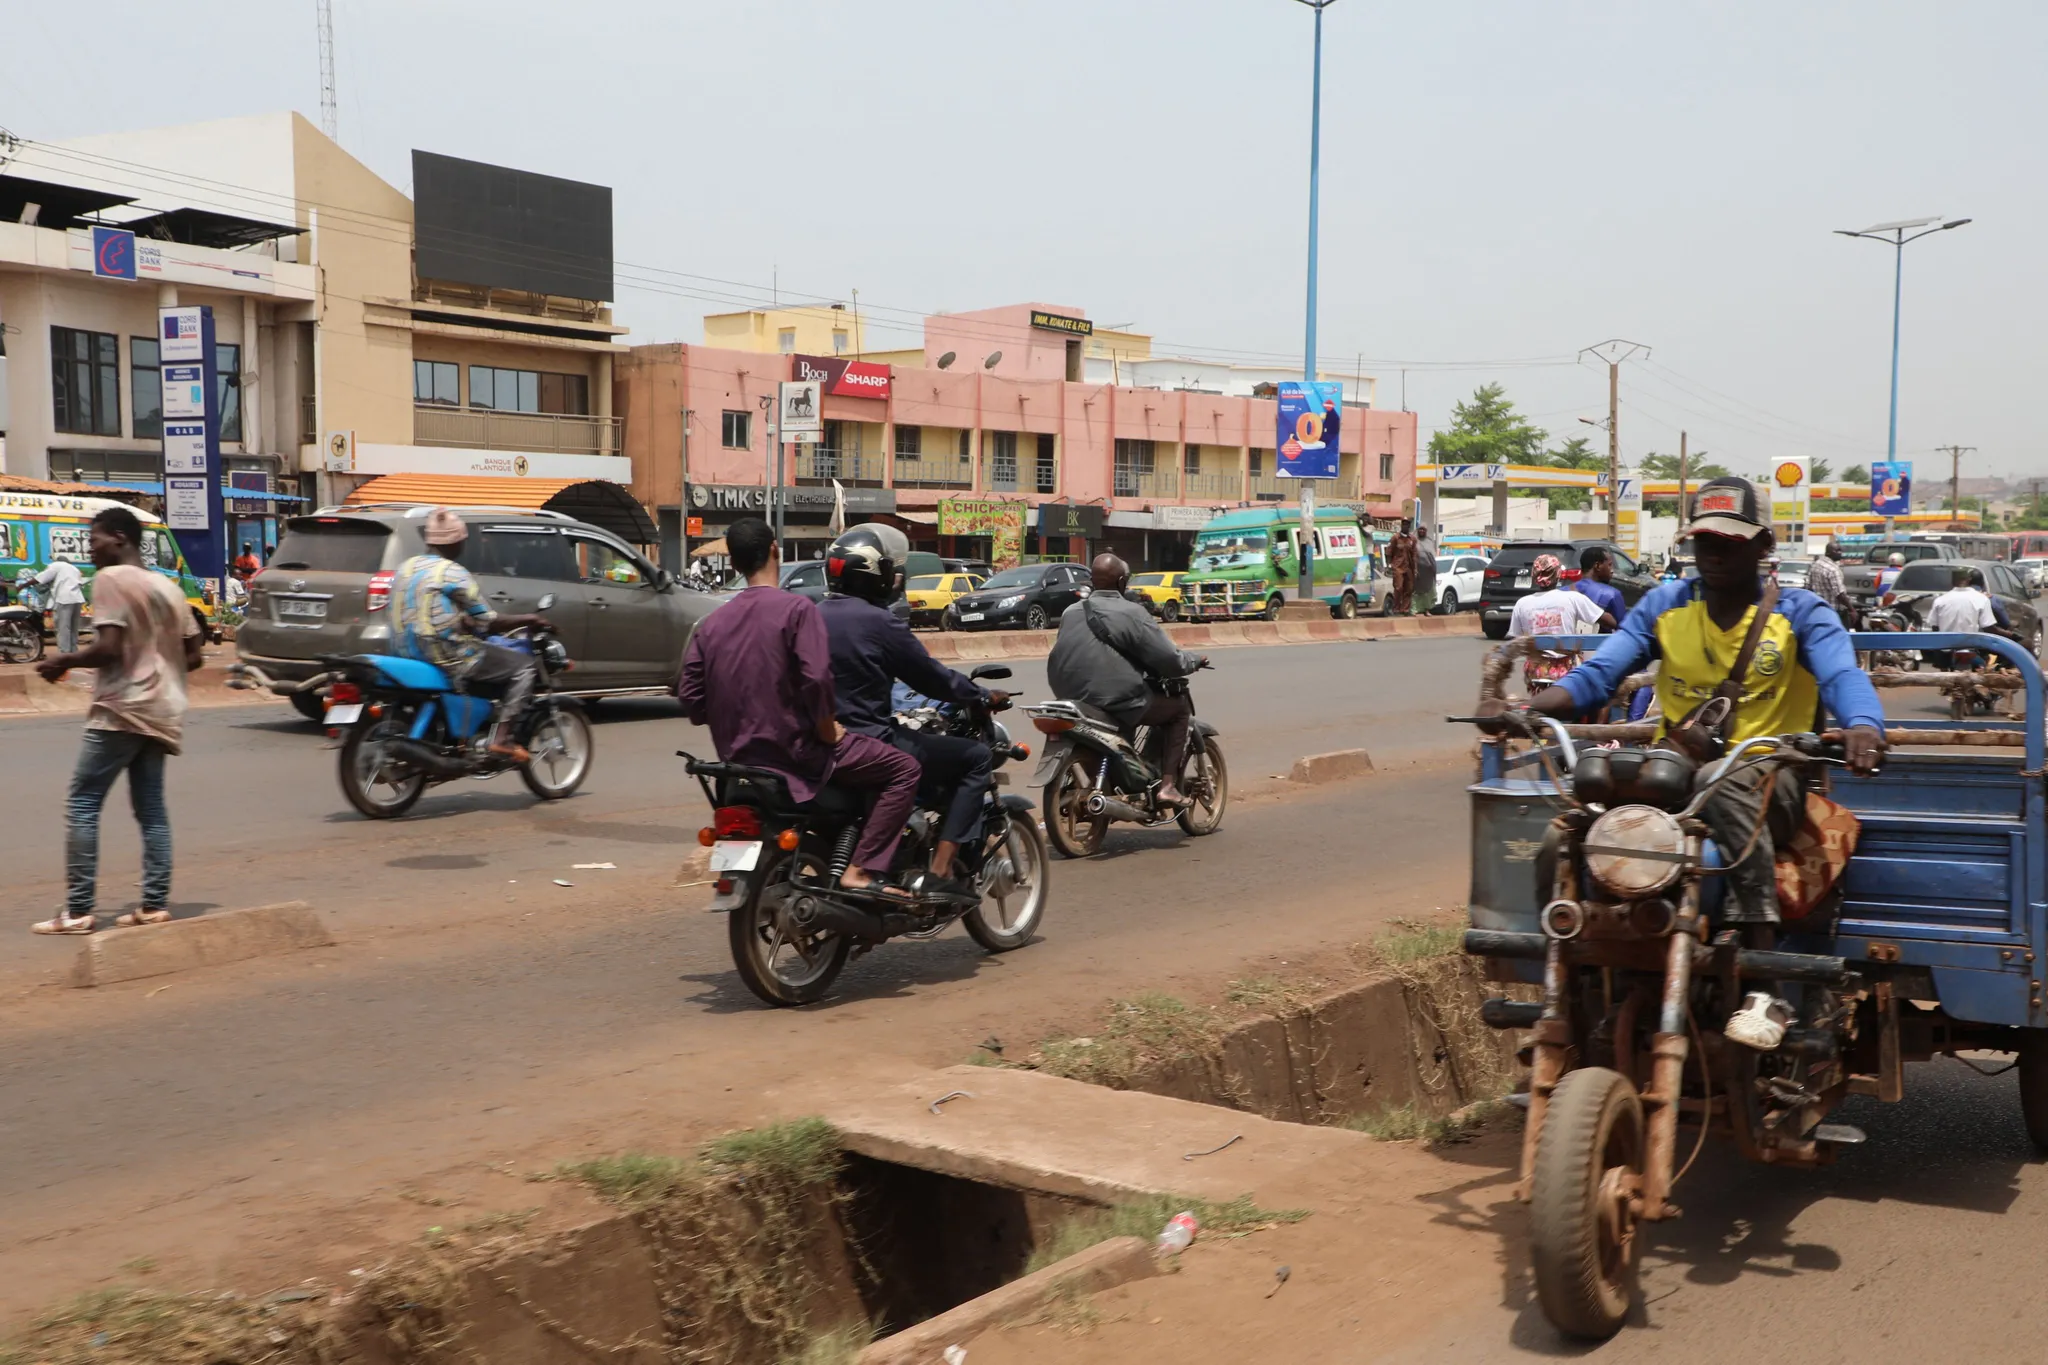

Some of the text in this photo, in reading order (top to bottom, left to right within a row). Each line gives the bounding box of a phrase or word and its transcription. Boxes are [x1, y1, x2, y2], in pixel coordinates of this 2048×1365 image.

[139, 246, 161, 256] CORIS
[139, 255, 161, 266] BANK
[179, 315, 197, 324] CORIS
[179, 324, 197, 333] BANK
[845, 373, 888, 387] SHARP
[484, 458, 511, 466] BANQUE
[470, 464, 512, 472] ATLANTIQUE
[712, 488, 751, 508] TMK
[57, 499, 84, 510] V8
[1067, 511, 1079, 526] BK
